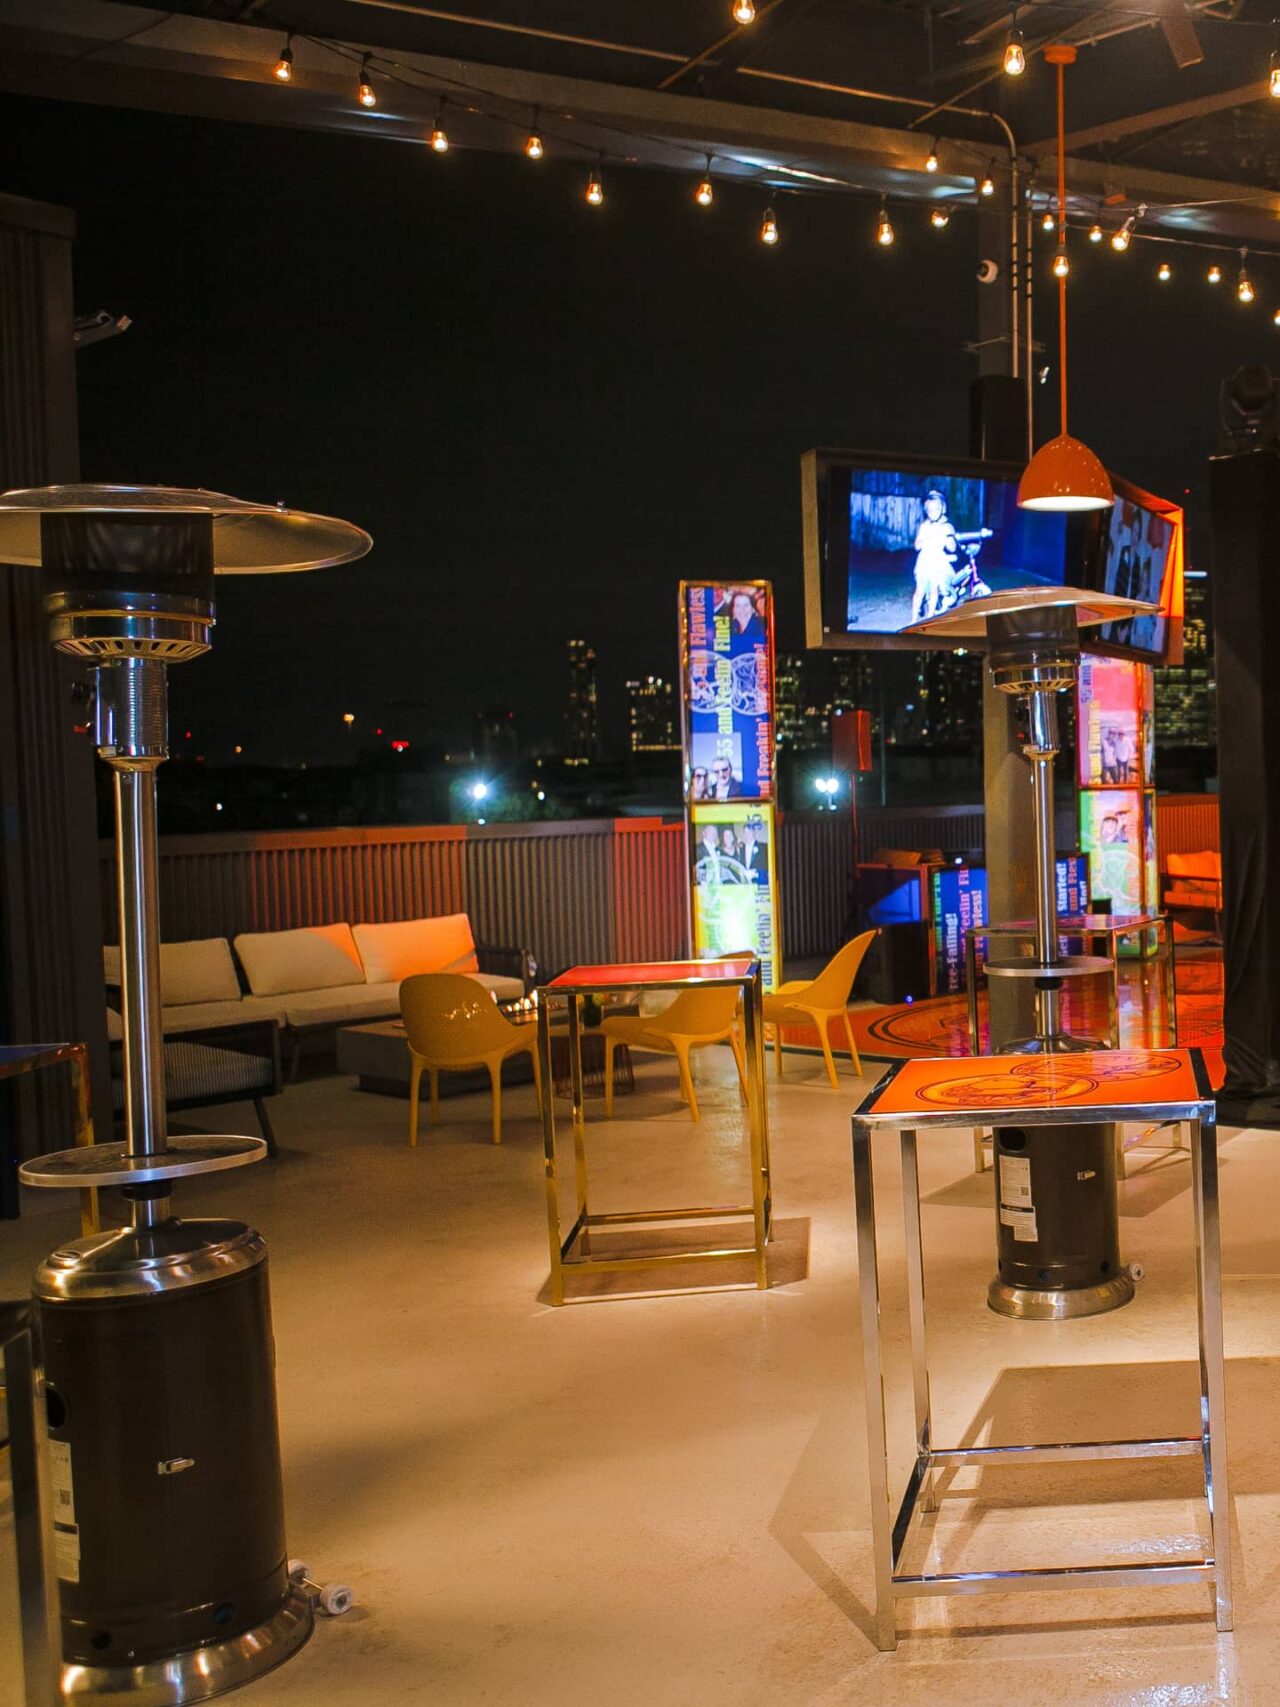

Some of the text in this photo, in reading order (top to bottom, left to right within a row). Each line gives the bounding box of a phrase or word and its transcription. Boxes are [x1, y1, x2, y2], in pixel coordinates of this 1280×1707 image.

[712, 615, 730, 652] Fine!
[716, 708, 733, 735] and
[1056, 863, 1068, 912] Started!
[945, 913, 958, 990] ree-Falling!
